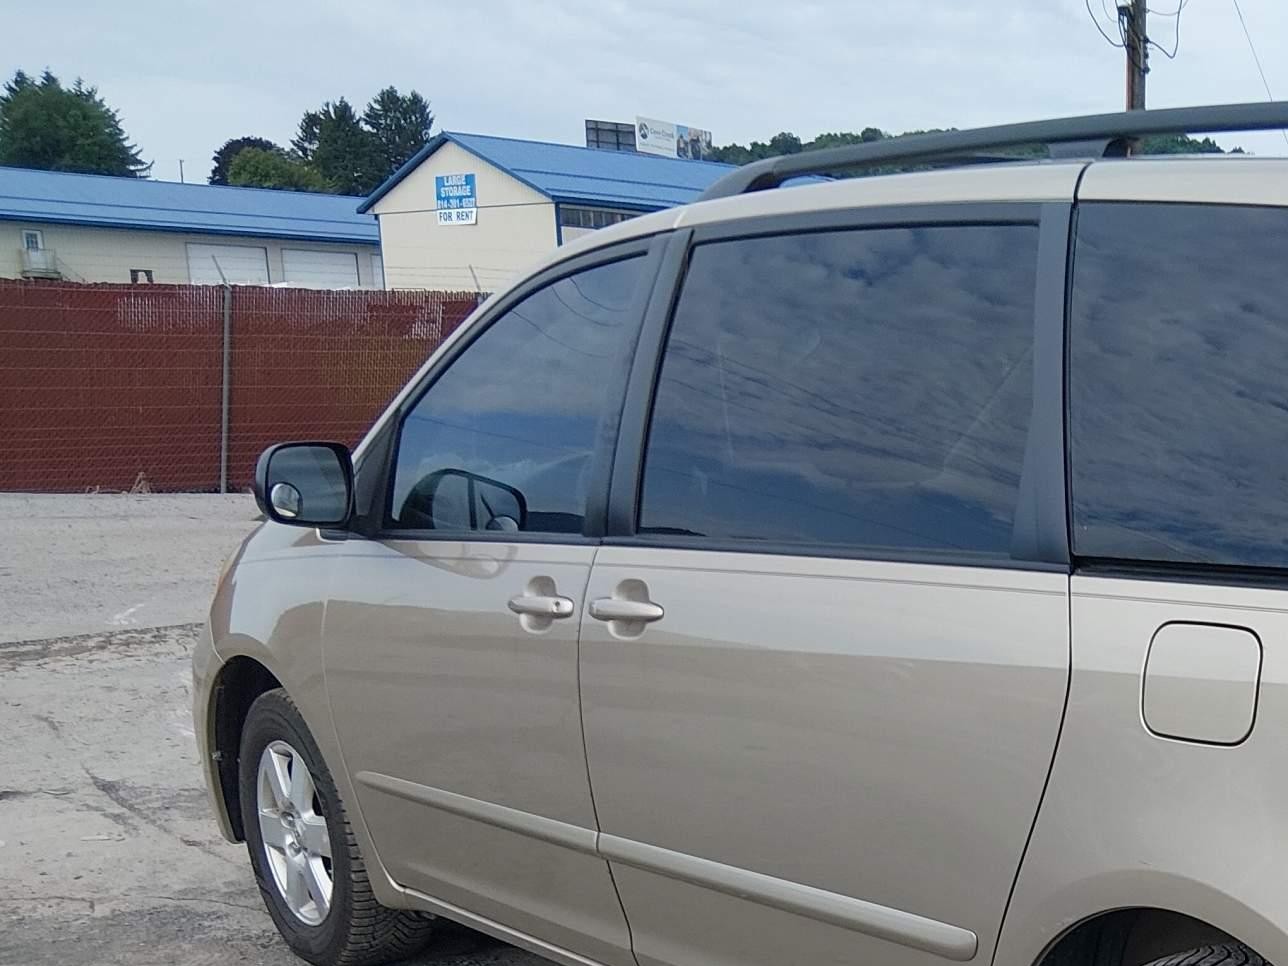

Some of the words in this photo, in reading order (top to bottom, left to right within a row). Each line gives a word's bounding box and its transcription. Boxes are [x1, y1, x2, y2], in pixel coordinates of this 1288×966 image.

[444, 175, 466, 186] LARGE
[440, 185, 471, 198] STORAGE
[440, 211, 453, 222] FOR
[456, 210, 473, 221] RENT
